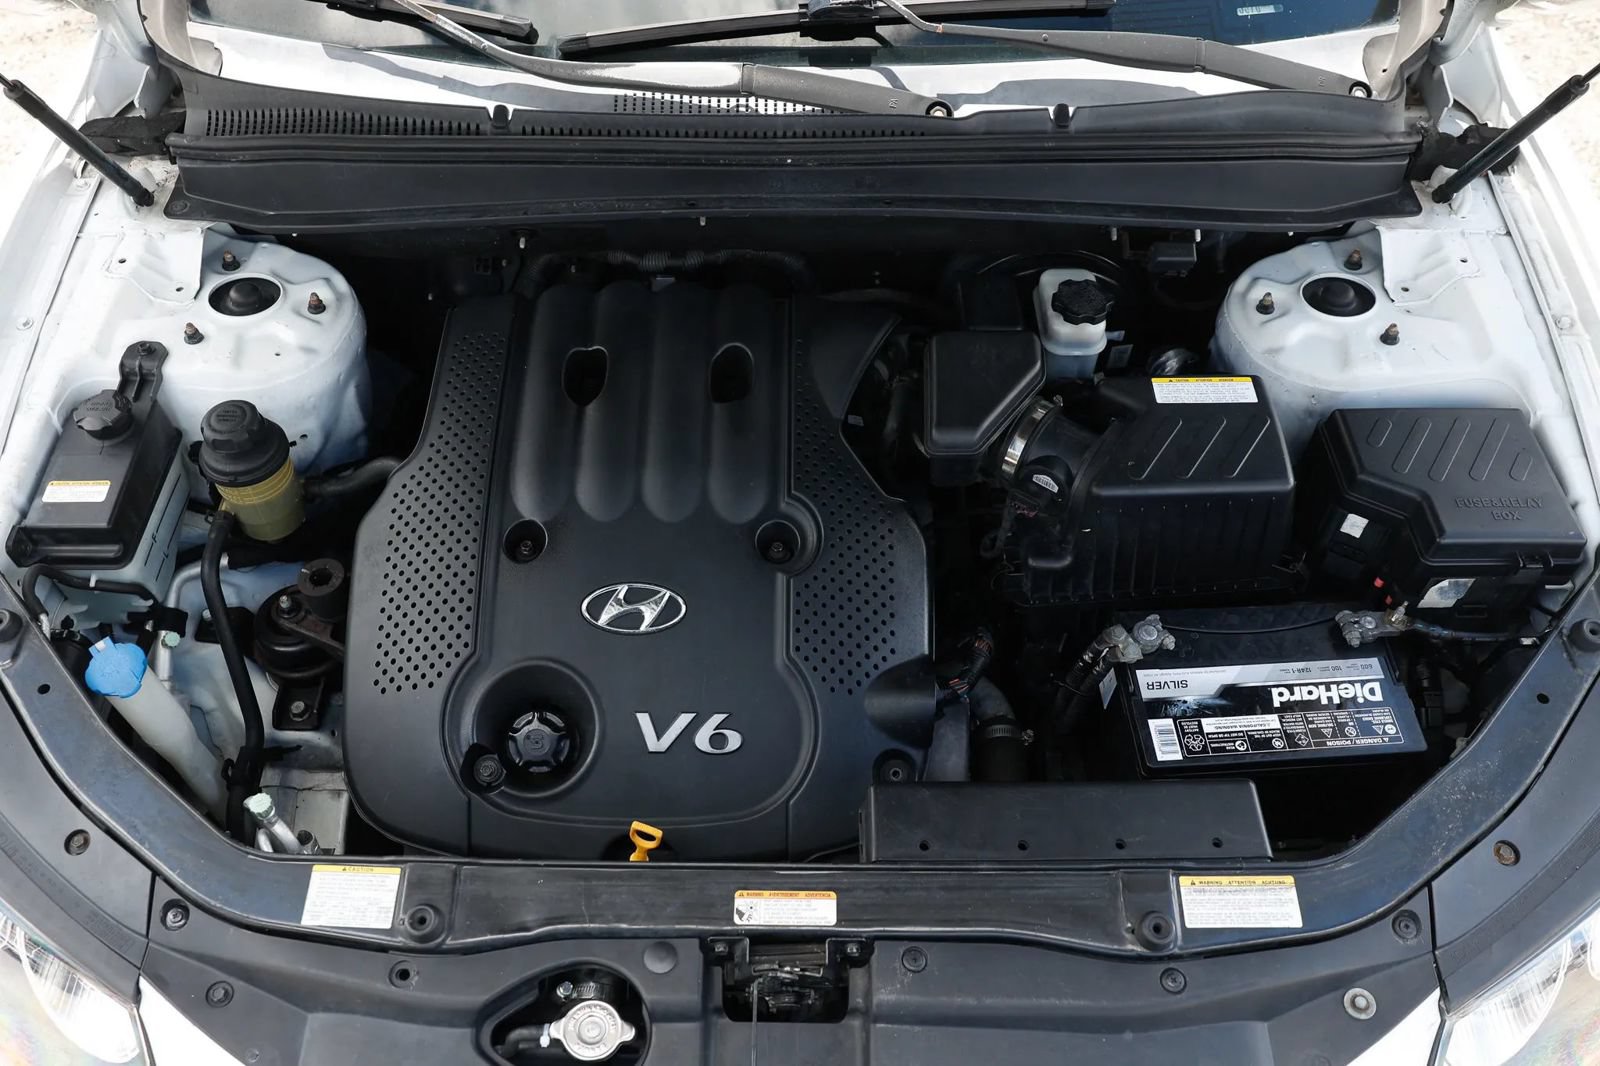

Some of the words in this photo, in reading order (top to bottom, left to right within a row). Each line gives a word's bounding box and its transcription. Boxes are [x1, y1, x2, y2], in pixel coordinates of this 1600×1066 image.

[1455, 497, 1543, 508] FUSE&RELAY
[1491, 511, 1522, 521] BOX
[1146, 680, 1189, 690] SILVER
[1271, 681, 1384, 707] DieHard
[635, 712, 743, 755] V6
